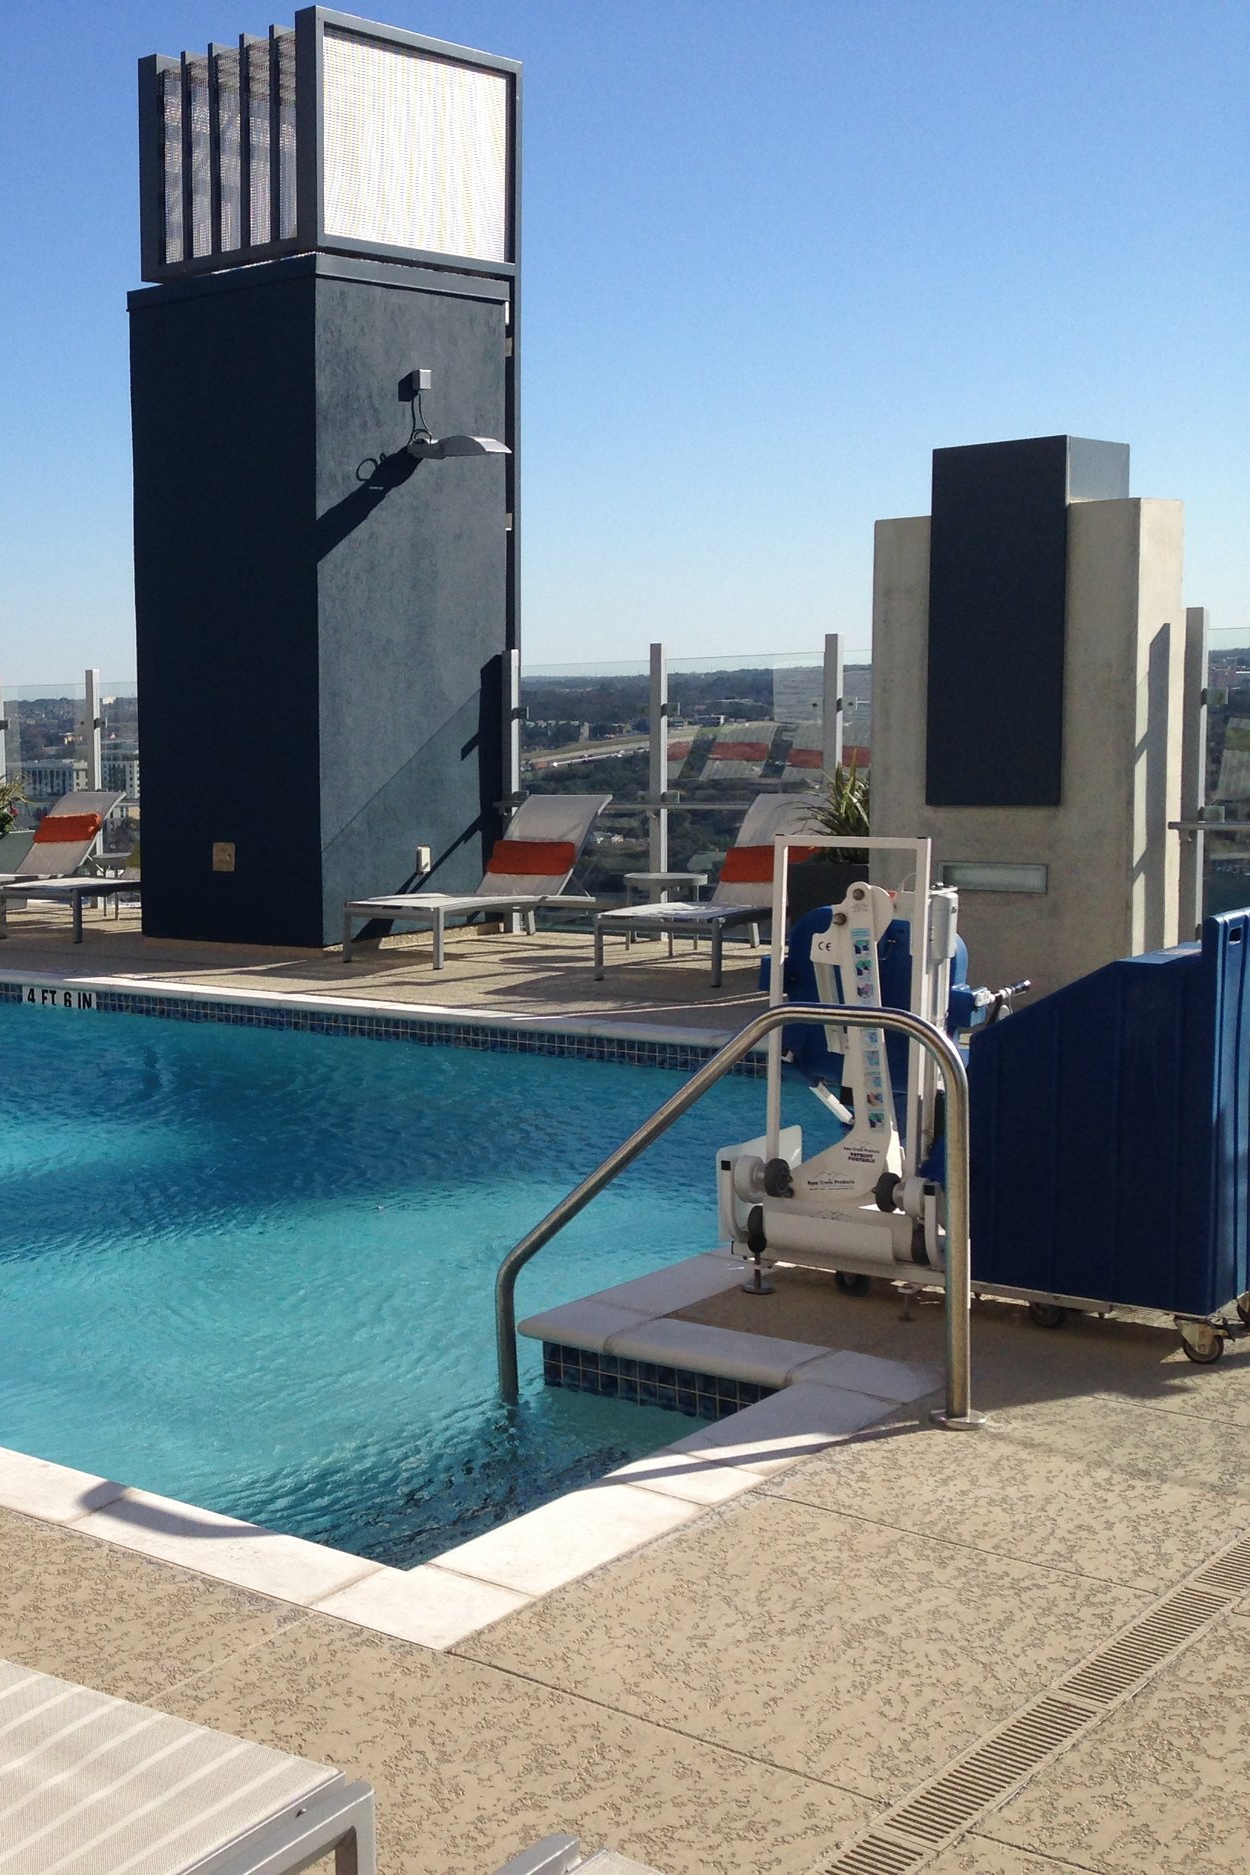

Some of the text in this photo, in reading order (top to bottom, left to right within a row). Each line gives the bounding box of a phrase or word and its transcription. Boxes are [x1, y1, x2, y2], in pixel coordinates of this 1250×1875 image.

[27, 987, 92, 1009] 4 FT 6 IN
